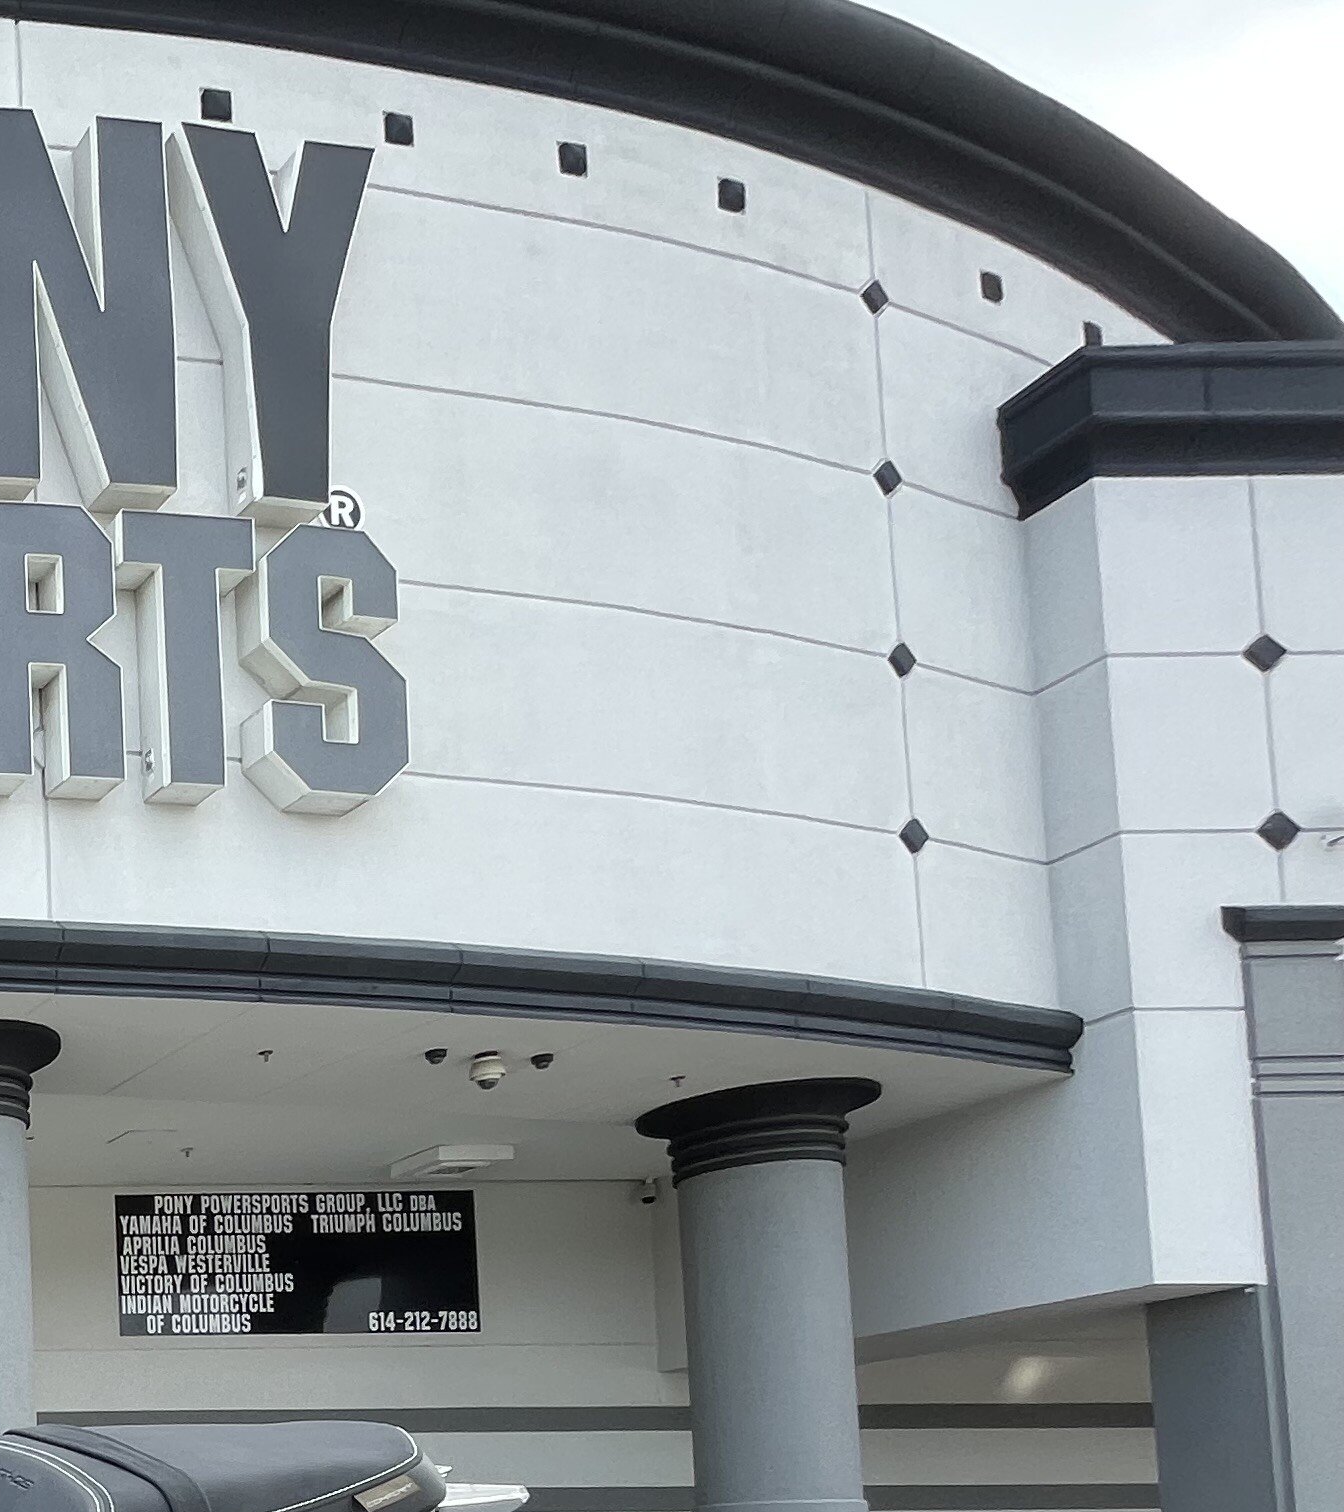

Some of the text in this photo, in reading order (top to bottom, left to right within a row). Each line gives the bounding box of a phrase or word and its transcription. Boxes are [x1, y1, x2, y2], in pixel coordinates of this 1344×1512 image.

[153, 1193, 436, 1217] PONY POWERSPORTS GROUP, LLC DBA
[119, 1214, 294, 1236] YAMAHA OF COLUMBUS
[310, 1212, 463, 1234] TRIUMPH COLUMBUS
[122, 1234, 267, 1256] APRILIA COLUMBUS
[120, 1254, 271, 1275] VESPA WESTERVILLE
[120, 1273, 294, 1295] VICTORY OF COLUMBUS
[121, 1294, 275, 1315] INDIAN MOTORCYCLE
[145, 1314, 252, 1335] OF COLUMBUS
[367, 1311, 478, 1332] 614-212-7888
